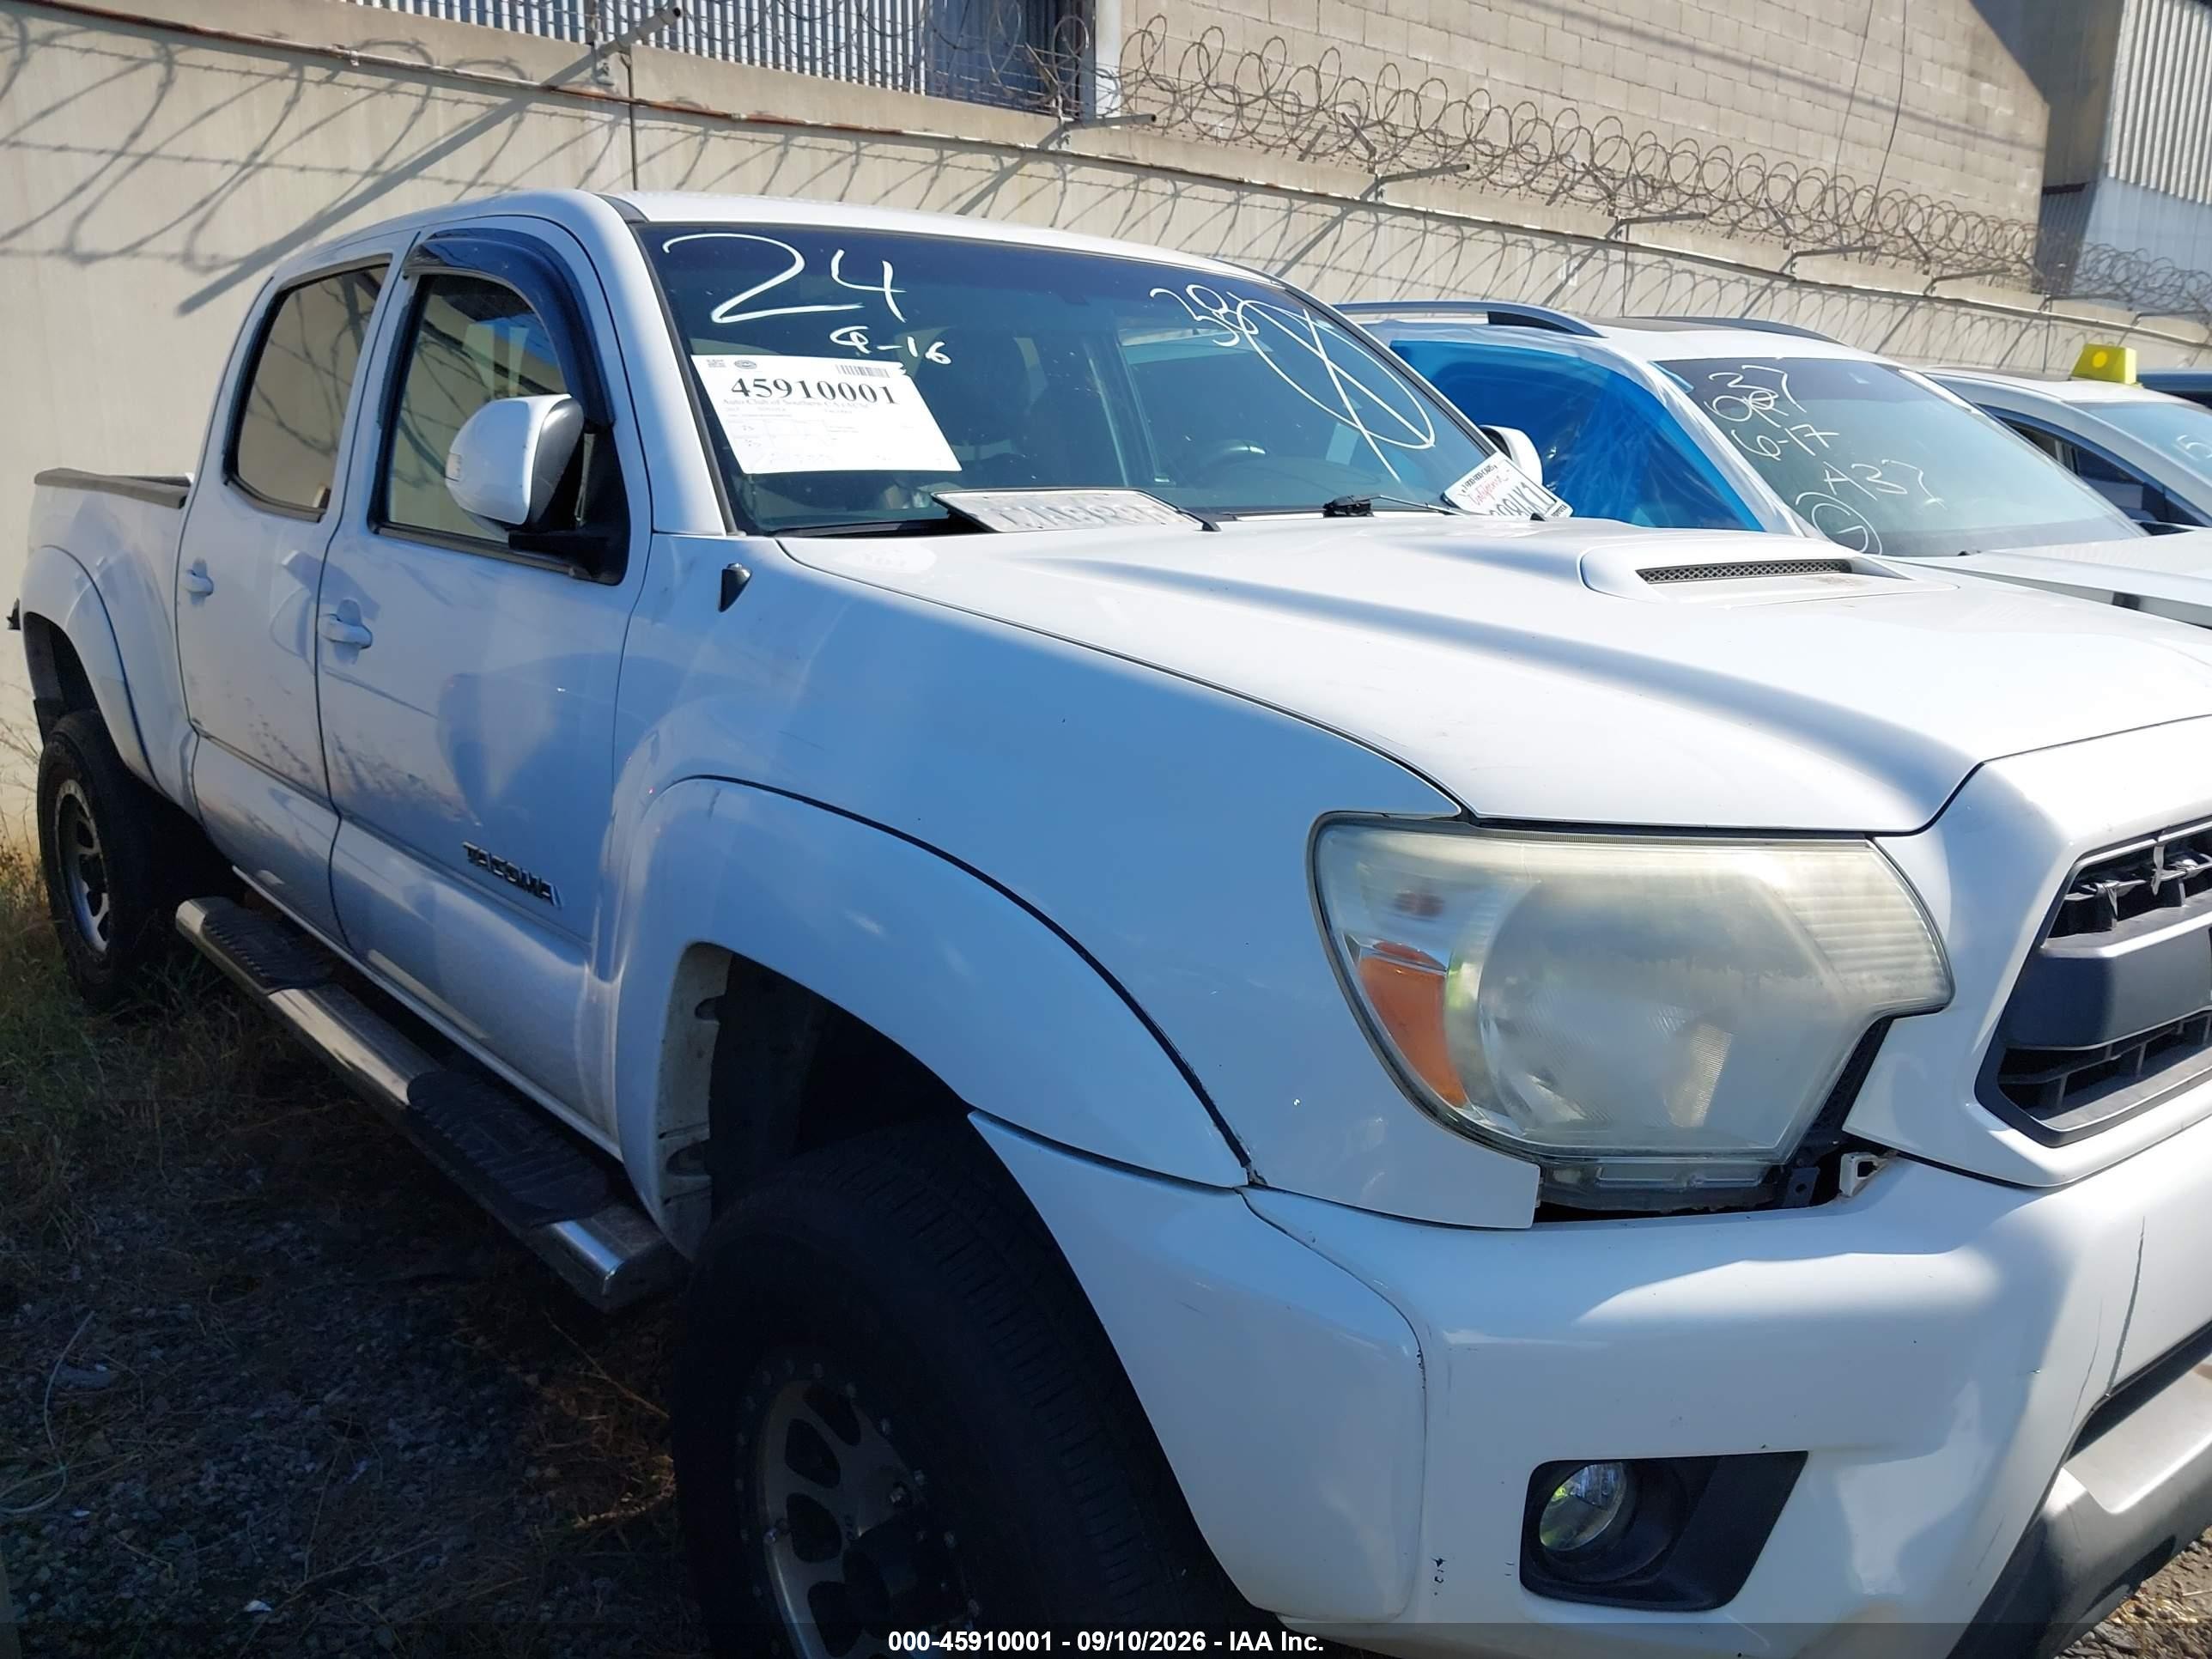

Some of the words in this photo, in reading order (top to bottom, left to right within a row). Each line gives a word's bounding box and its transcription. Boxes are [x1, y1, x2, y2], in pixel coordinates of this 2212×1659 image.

[662, 233, 907, 323] 24
[731, 377, 899, 405] 45910001
[462, 841, 564, 909] TACOMA
